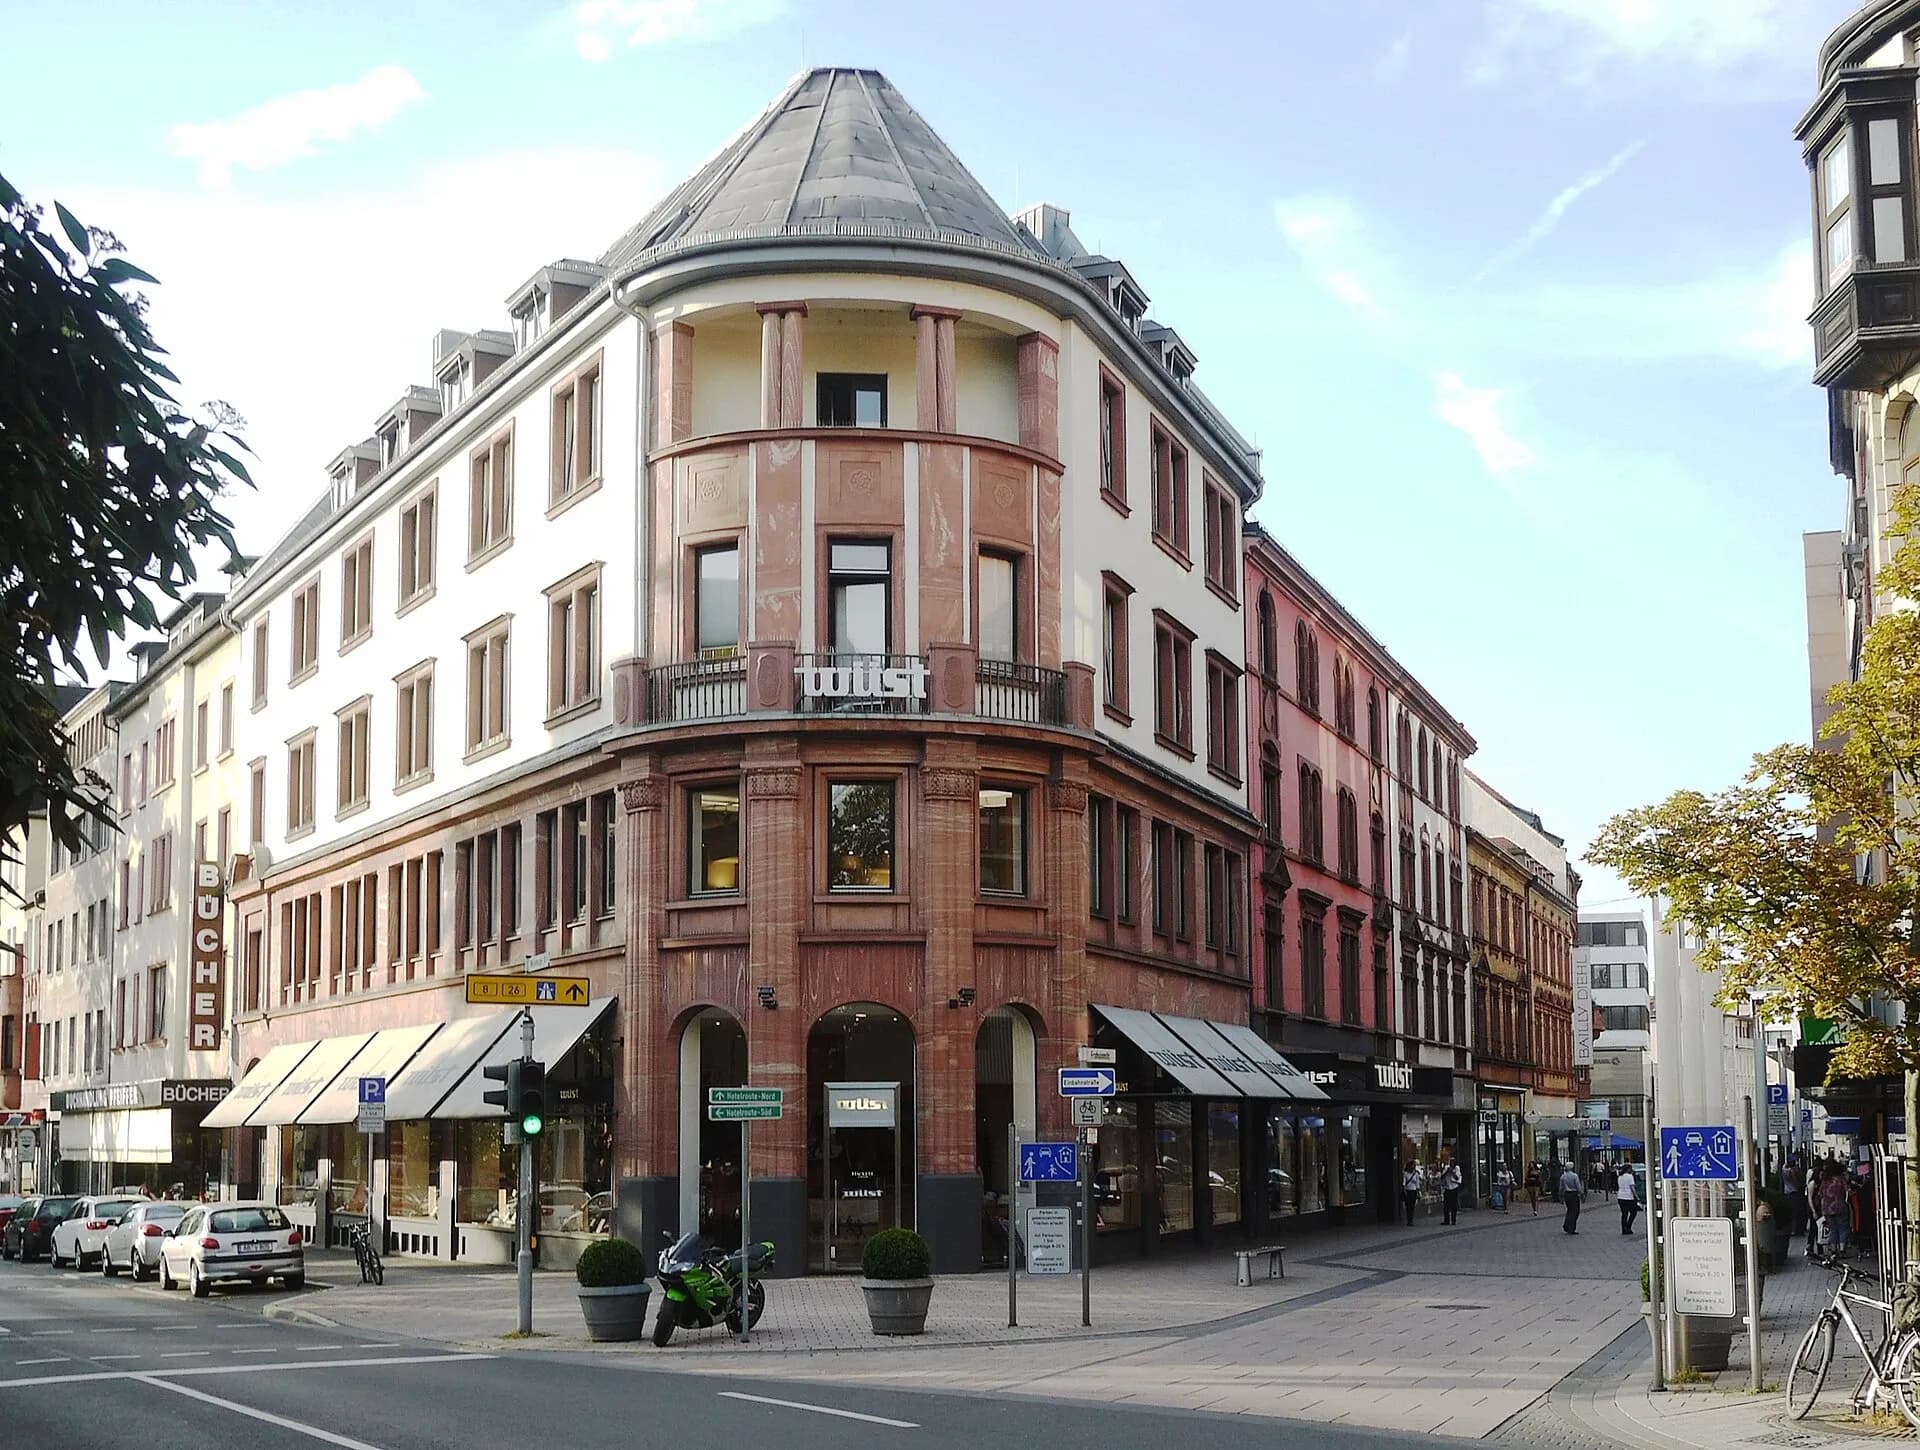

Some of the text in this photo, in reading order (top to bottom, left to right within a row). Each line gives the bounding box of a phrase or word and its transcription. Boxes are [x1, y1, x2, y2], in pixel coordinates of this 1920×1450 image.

[794, 660, 930, 698] wüst
[194, 864, 219, 1046] BÜCHER
[482, 985, 520, 994] 8 26
[1577, 954, 1589, 1058] BAILLY DIEHL
[1148, 1049, 1206, 1069] wüst
[1207, 1055, 1258, 1074] wüst
[1256, 1060, 1300, 1077] wüst
[1302, 1071, 1337, 1084] üst
[1374, 1061, 1412, 1089] wüst
[1480, 1111, 1496, 1121] Tee
